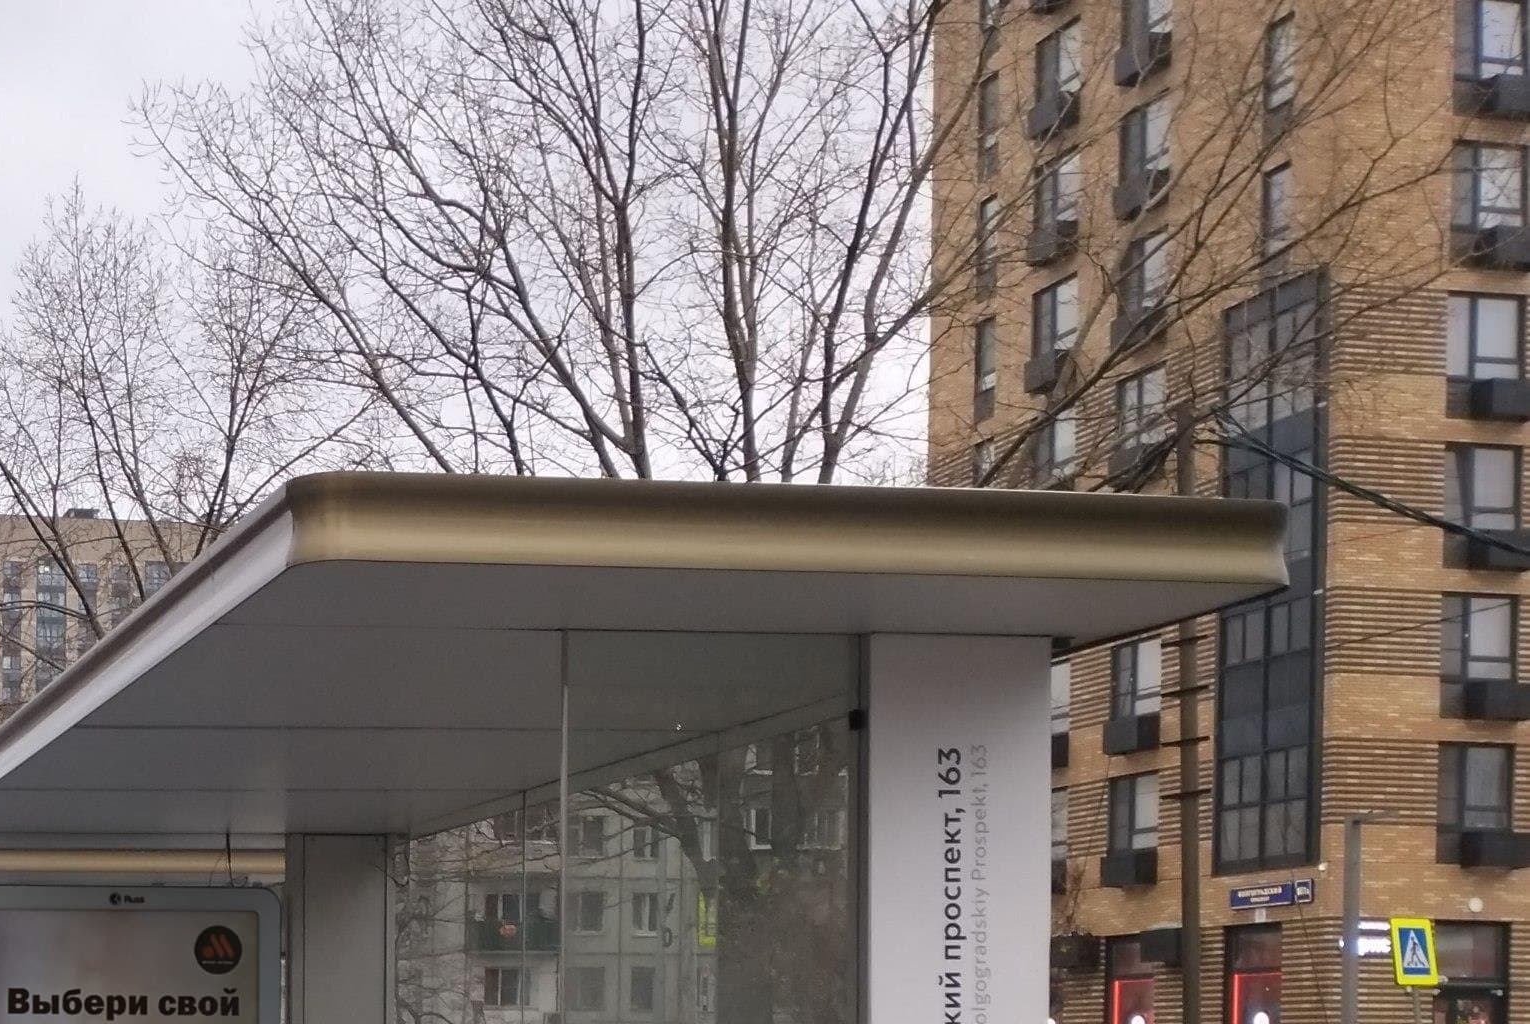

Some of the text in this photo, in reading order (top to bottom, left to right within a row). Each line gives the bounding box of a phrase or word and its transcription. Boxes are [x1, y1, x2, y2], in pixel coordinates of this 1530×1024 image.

[937, 747, 961, 799] 163
[971, 744, 987, 777] 163
[971, 783, 990, 881] Prospekt,
[944, 808, 967, 960] проспект,
[7, 987, 240, 1021] Выбери свой
